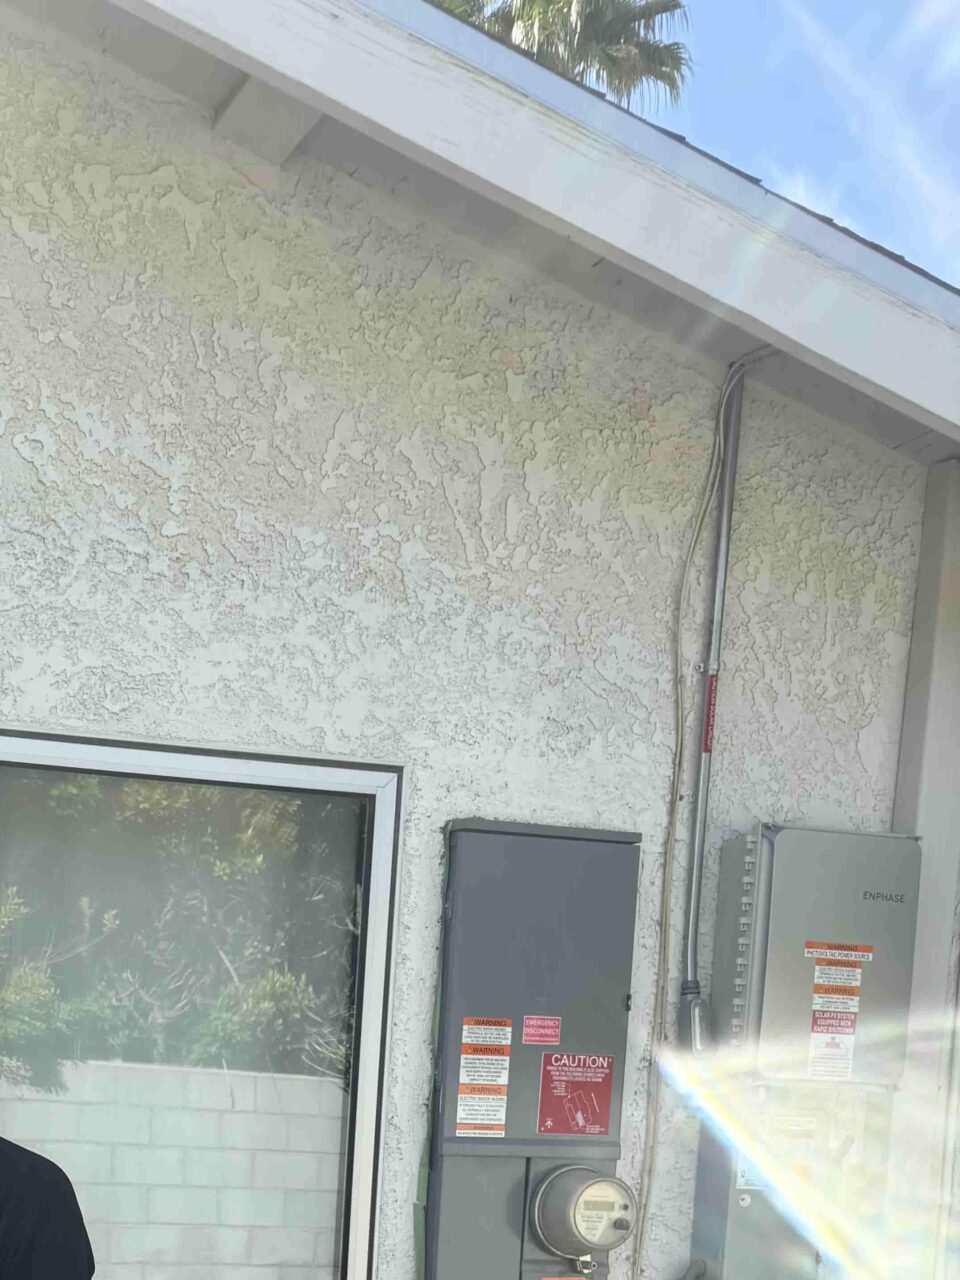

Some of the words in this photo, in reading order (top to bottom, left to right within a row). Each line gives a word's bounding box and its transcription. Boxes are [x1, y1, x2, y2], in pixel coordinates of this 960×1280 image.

[863, 890, 905, 903] ENPHASE
[827, 943, 858, 952] WARNING
[826, 959, 857, 968] WARNING
[824, 987, 855, 996] WARNING
[474, 1018, 507, 1027] WARNING
[472, 1047, 505, 1055] WARNING
[551, 1054, 608, 1068] CAUTION
[469, 1086, 502, 1095] WARNING
